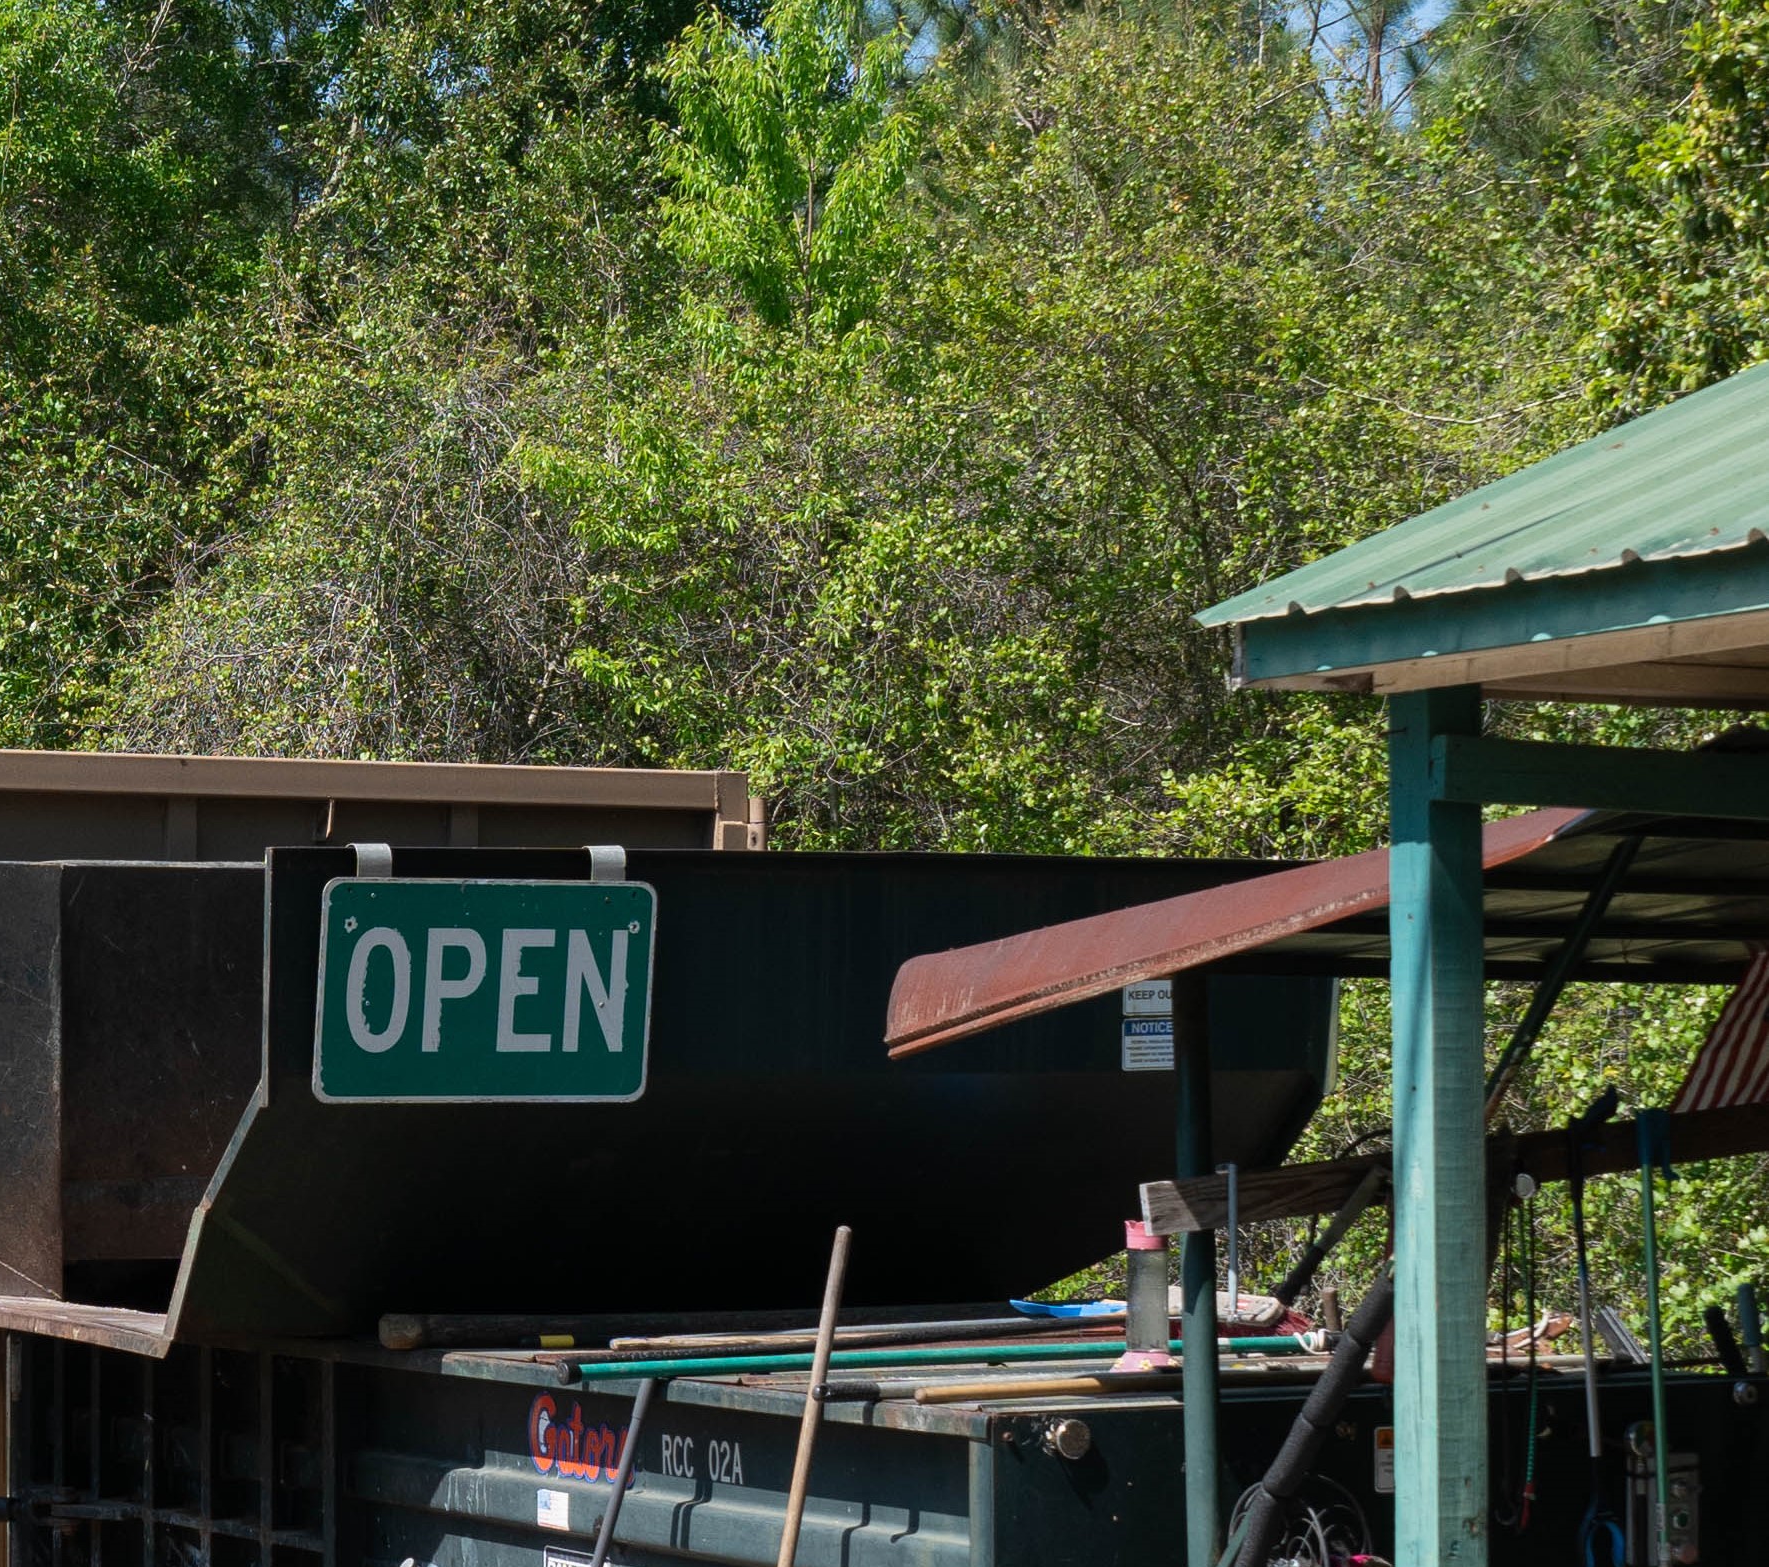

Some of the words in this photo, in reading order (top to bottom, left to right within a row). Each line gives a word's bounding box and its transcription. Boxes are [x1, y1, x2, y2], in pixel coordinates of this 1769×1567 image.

[346, 926, 629, 1053] OPEN
[1128, 990, 1155, 1000] KEEP
[1157, 990, 1173, 1000] OU
[1131, 1022, 1173, 1034] NOTICE
[662, 1434, 694, 1477] RCC
[709, 1440, 743, 1484] 02A
